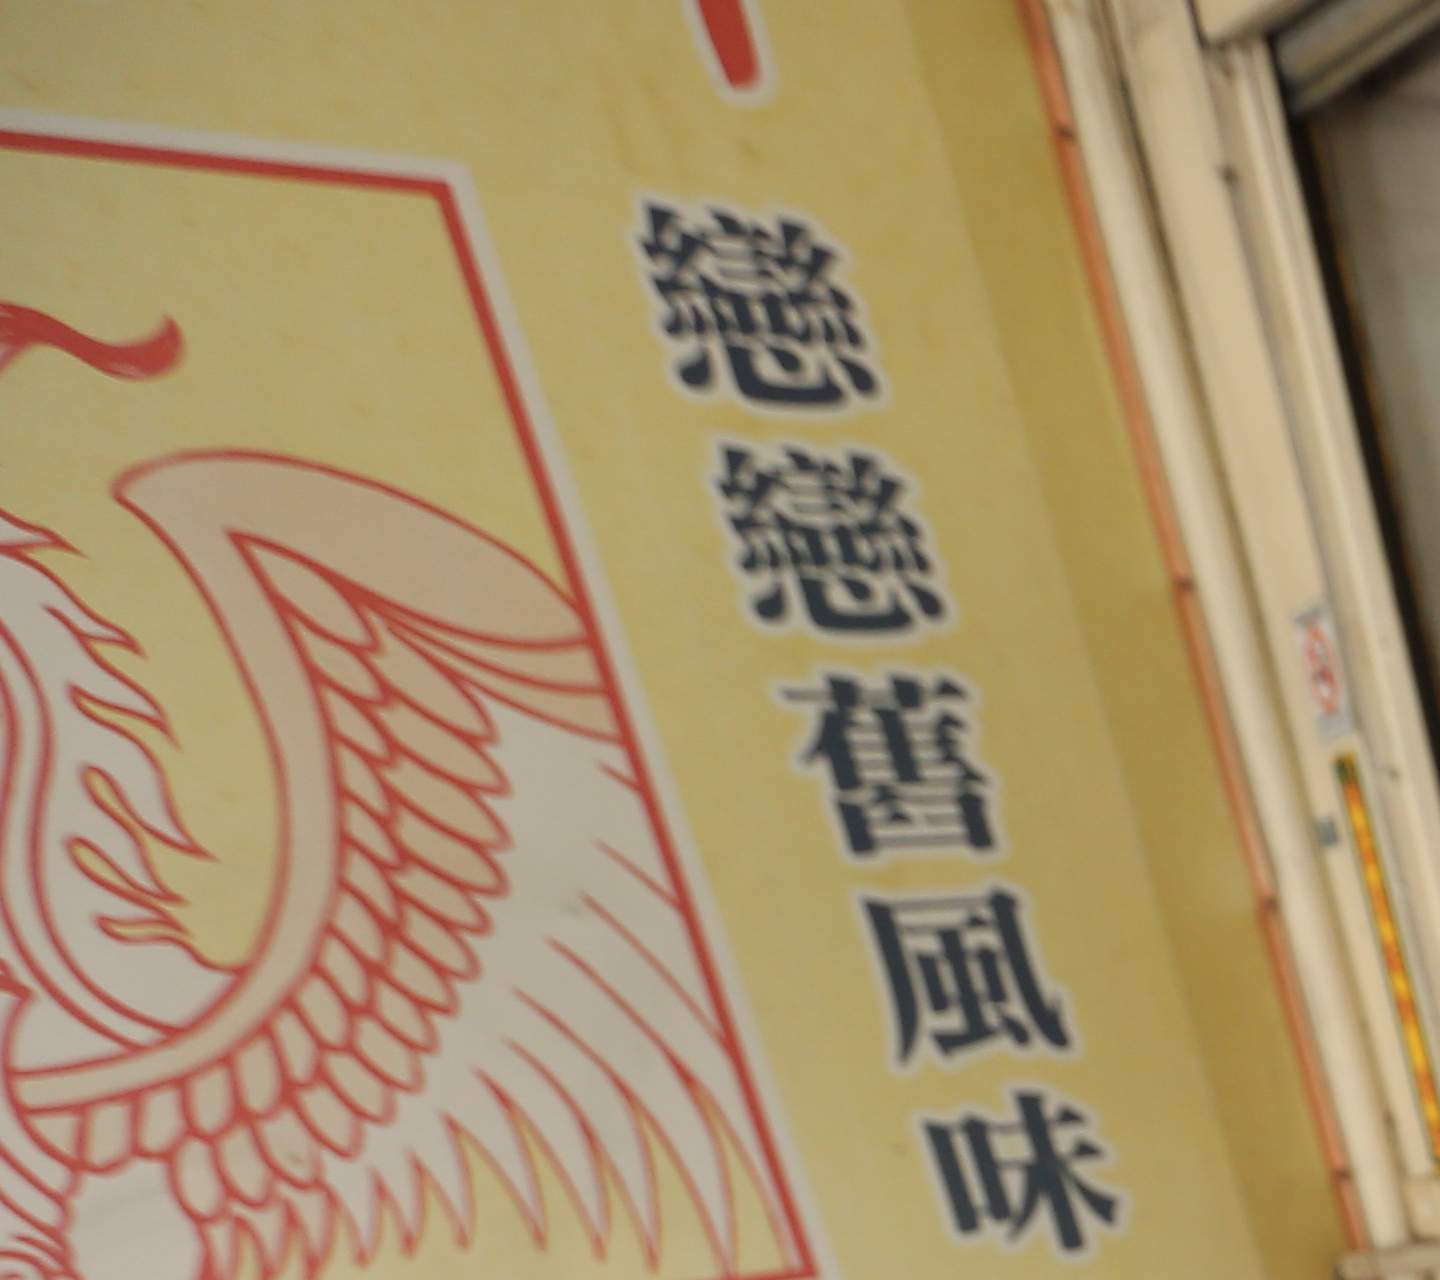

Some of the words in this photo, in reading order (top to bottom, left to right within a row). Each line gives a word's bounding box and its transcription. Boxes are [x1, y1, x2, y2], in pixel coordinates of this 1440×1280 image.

[640, 201, 1118, 1252] 戀戀舊風味
